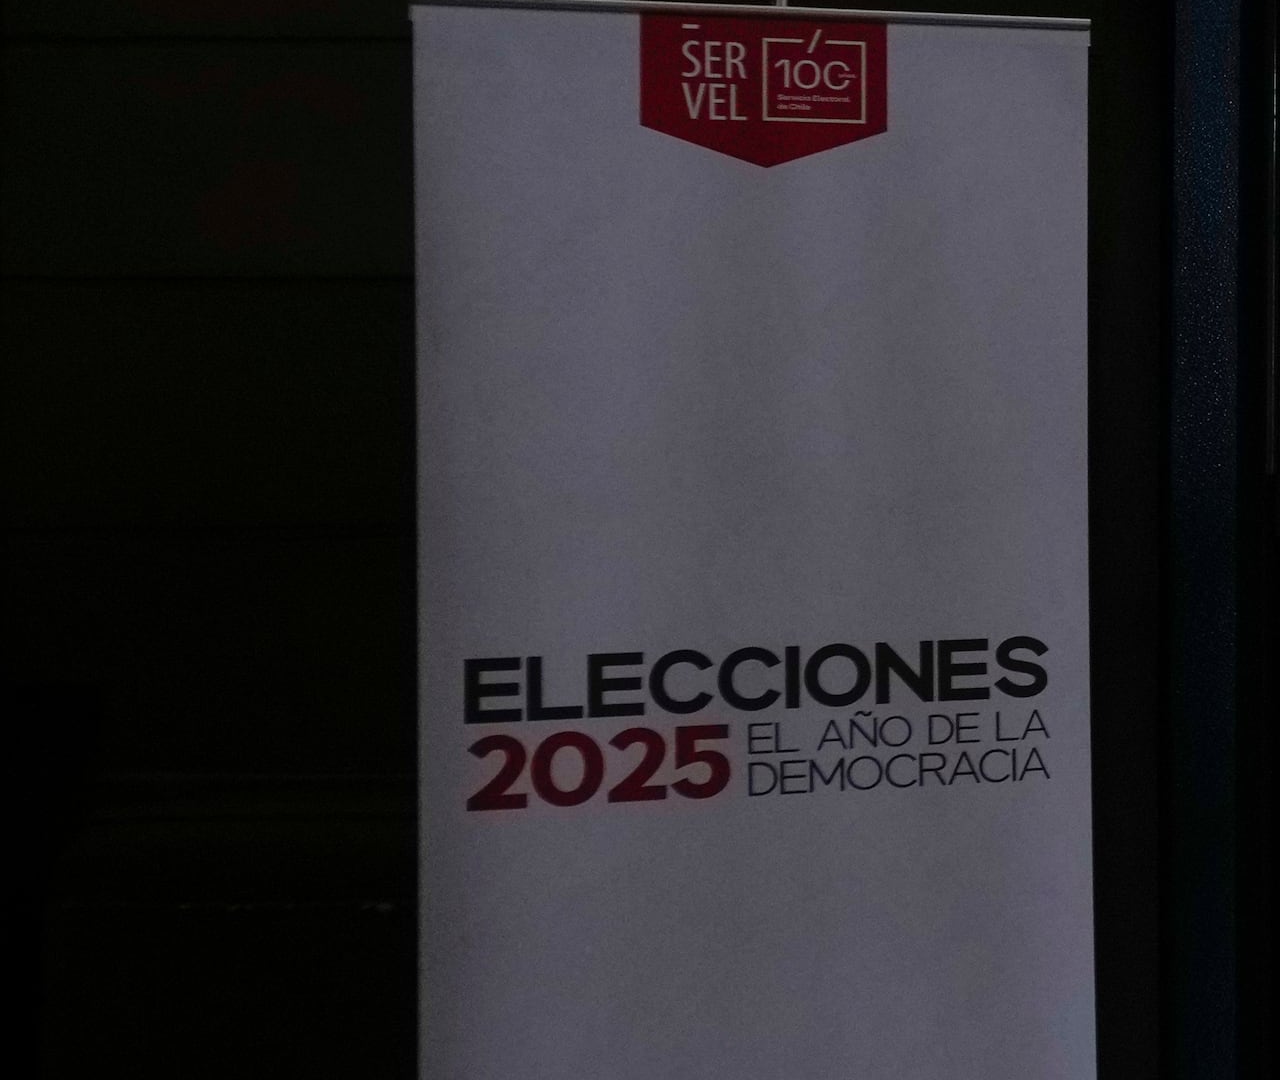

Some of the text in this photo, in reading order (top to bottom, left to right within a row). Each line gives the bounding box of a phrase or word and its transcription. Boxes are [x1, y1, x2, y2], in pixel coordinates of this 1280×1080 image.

[681, 40, 748, 79] SER
[681, 82, 748, 121] VEL
[463, 635, 1050, 725] ELECCIONES
[747, 708, 1051, 755] EL AÑO DE LA
[465, 724, 731, 812] 2025
[747, 746, 1052, 798] DEMOCRACIA
